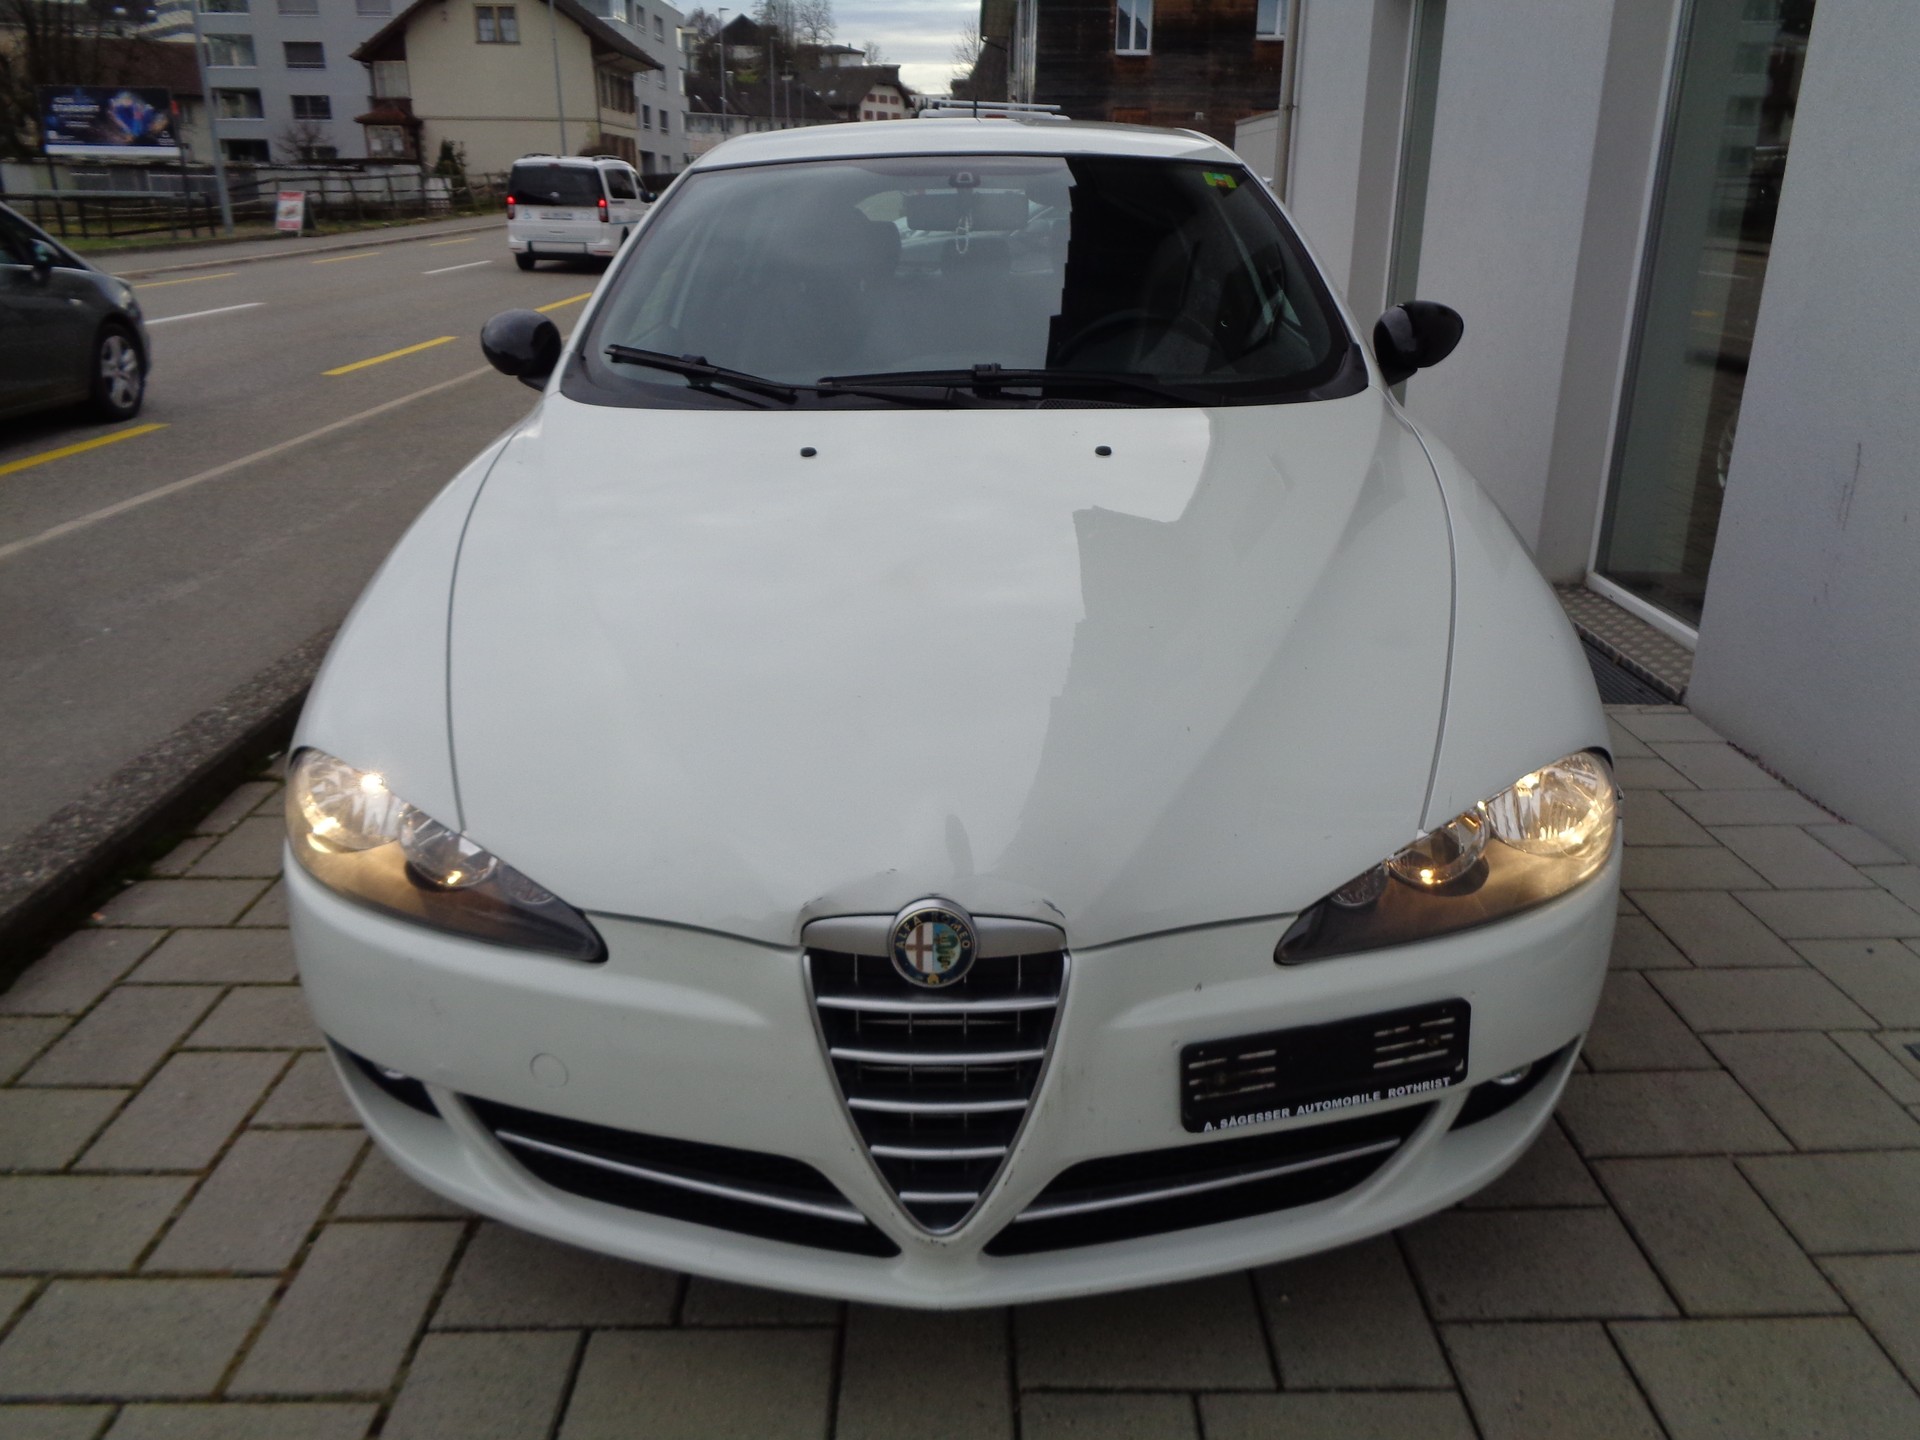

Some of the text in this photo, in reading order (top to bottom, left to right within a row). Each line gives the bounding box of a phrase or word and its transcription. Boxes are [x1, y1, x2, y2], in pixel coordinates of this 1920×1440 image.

[896, 915, 921, 948] ALFA
[1296, 1091, 1381, 1115] AUTOMOBILE
[1387, 1076, 1450, 1098] ROTHRIST
